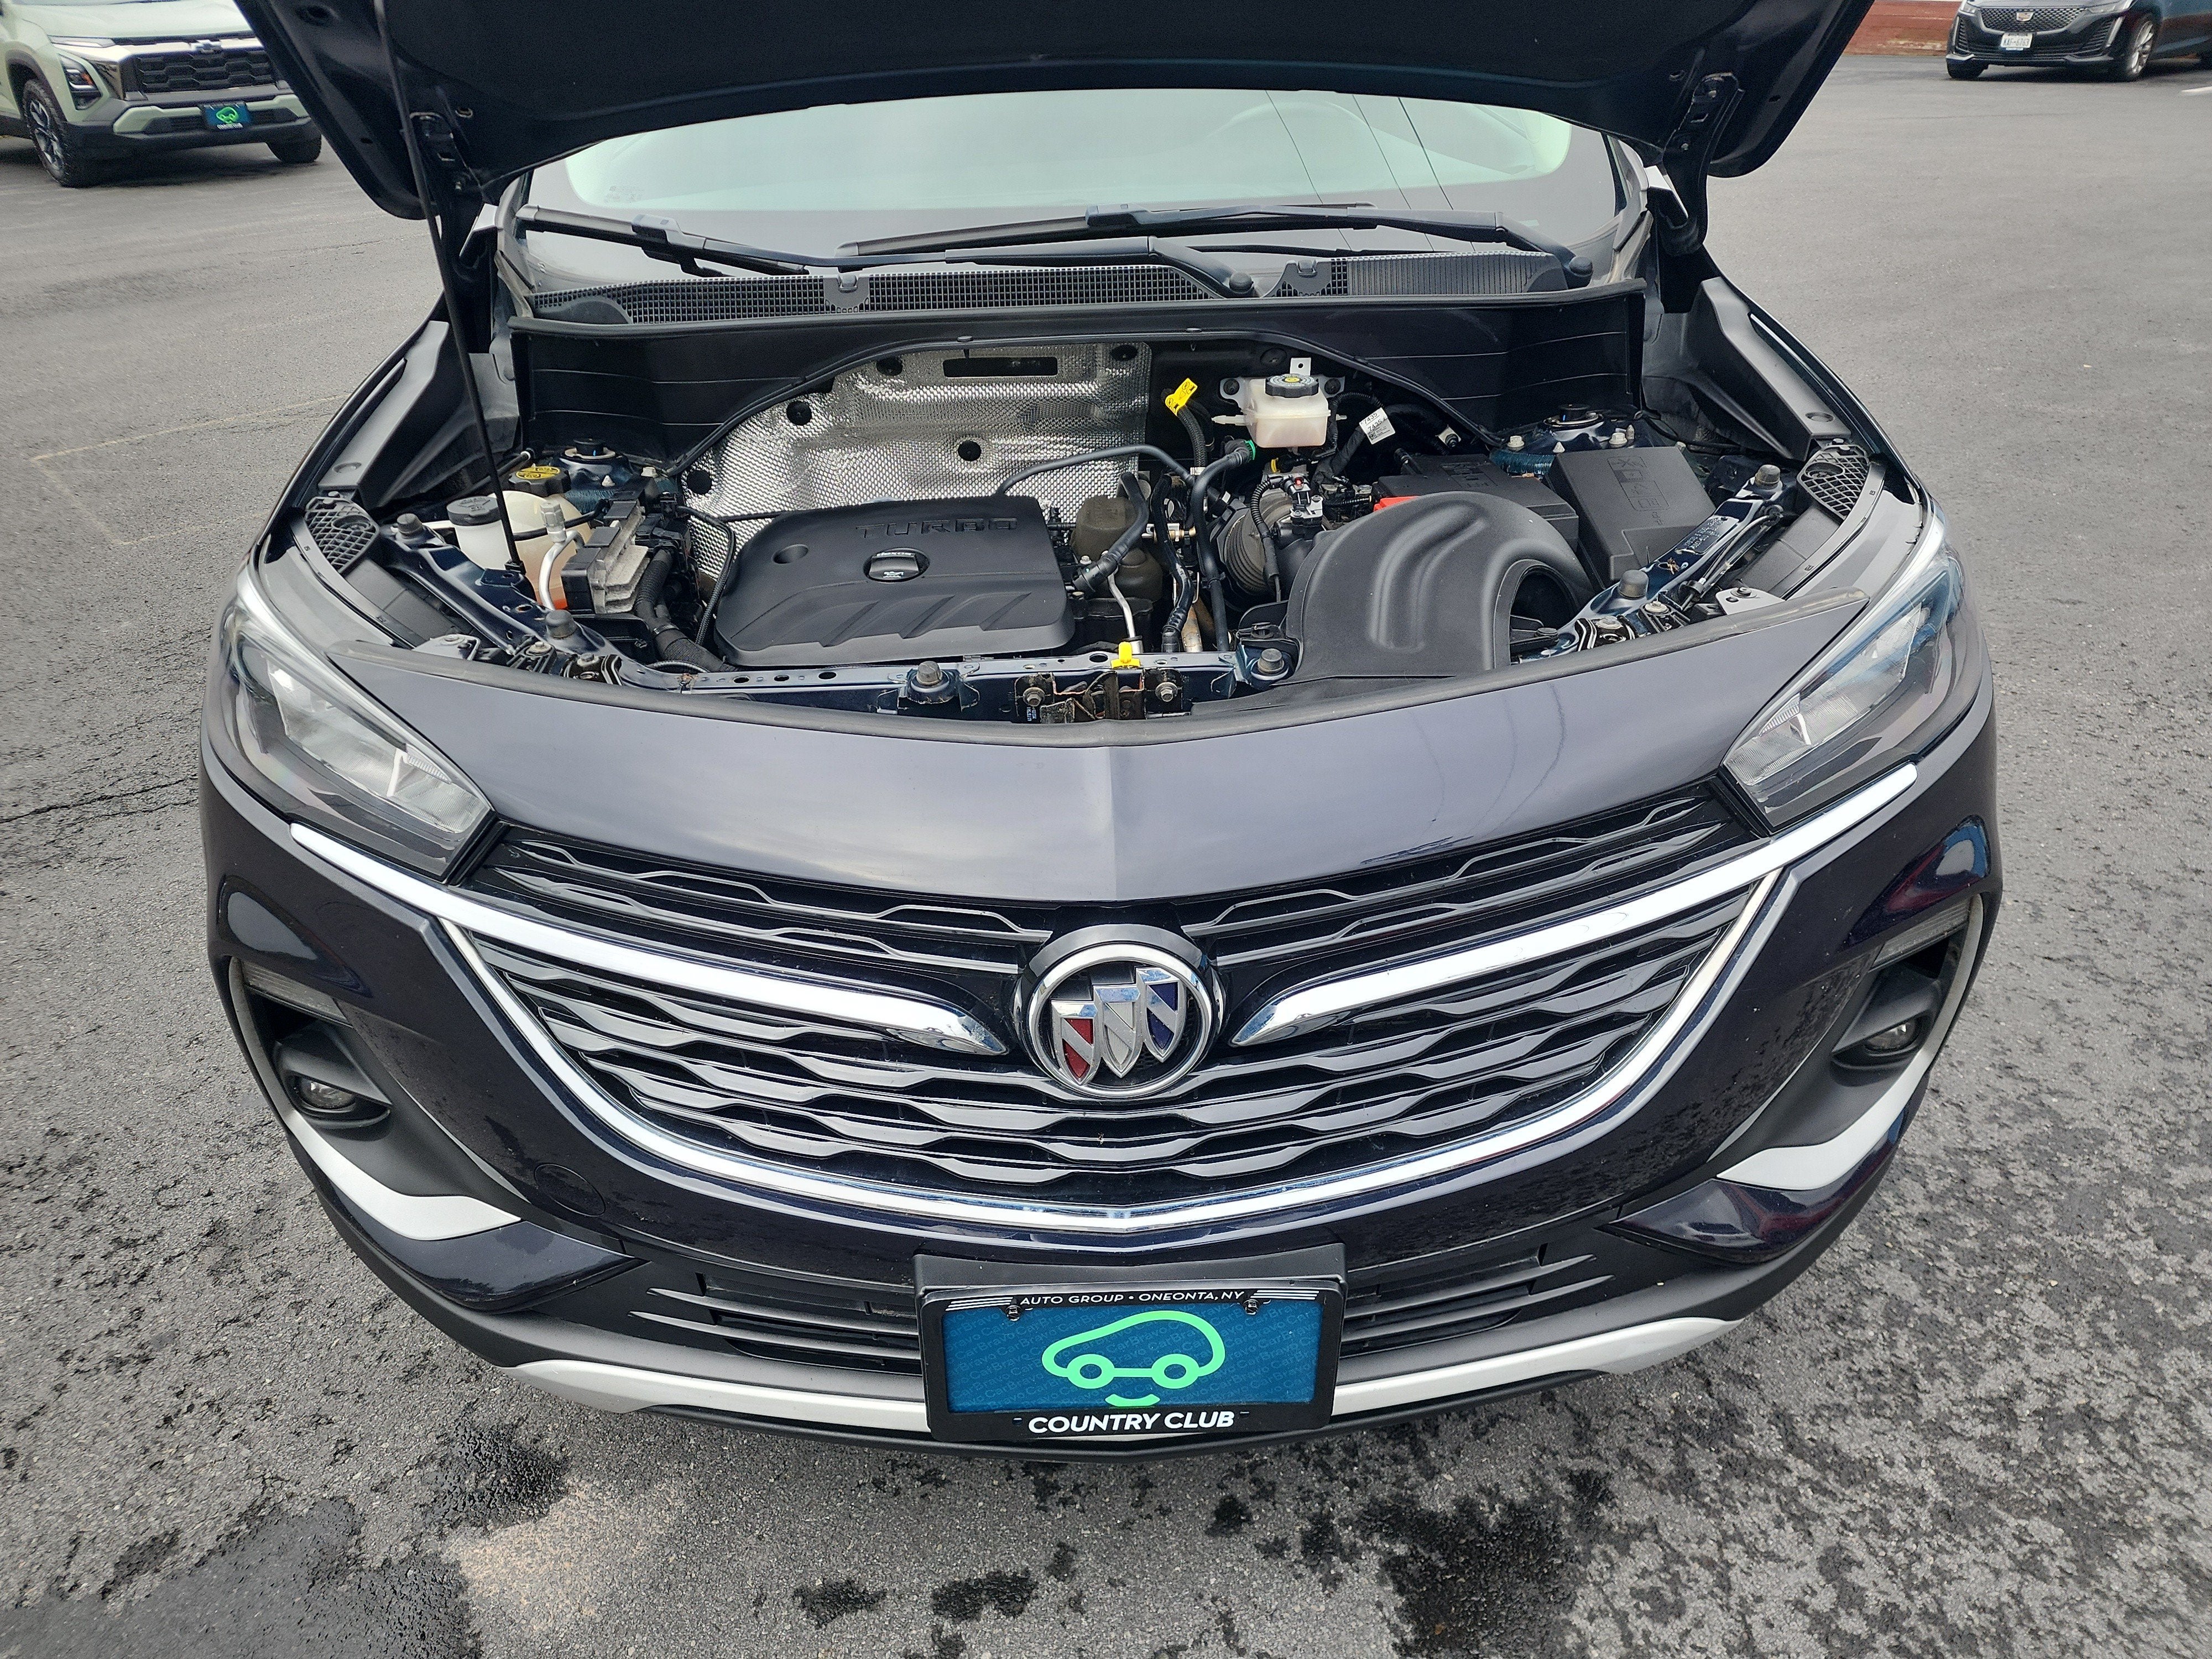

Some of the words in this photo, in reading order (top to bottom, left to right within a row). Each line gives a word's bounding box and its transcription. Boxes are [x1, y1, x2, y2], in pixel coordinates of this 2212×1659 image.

[1363, 413, 1378, 424] 7435
[855, 517, 1018, 538] TURBO
[1020, 1296, 1063, 1305] AUTO
[1068, 1294, 1124, 1303] GROUP
[1029, 1412, 1160, 1434] COUNTRY
[1164, 1411, 1235, 1429] CLUB
